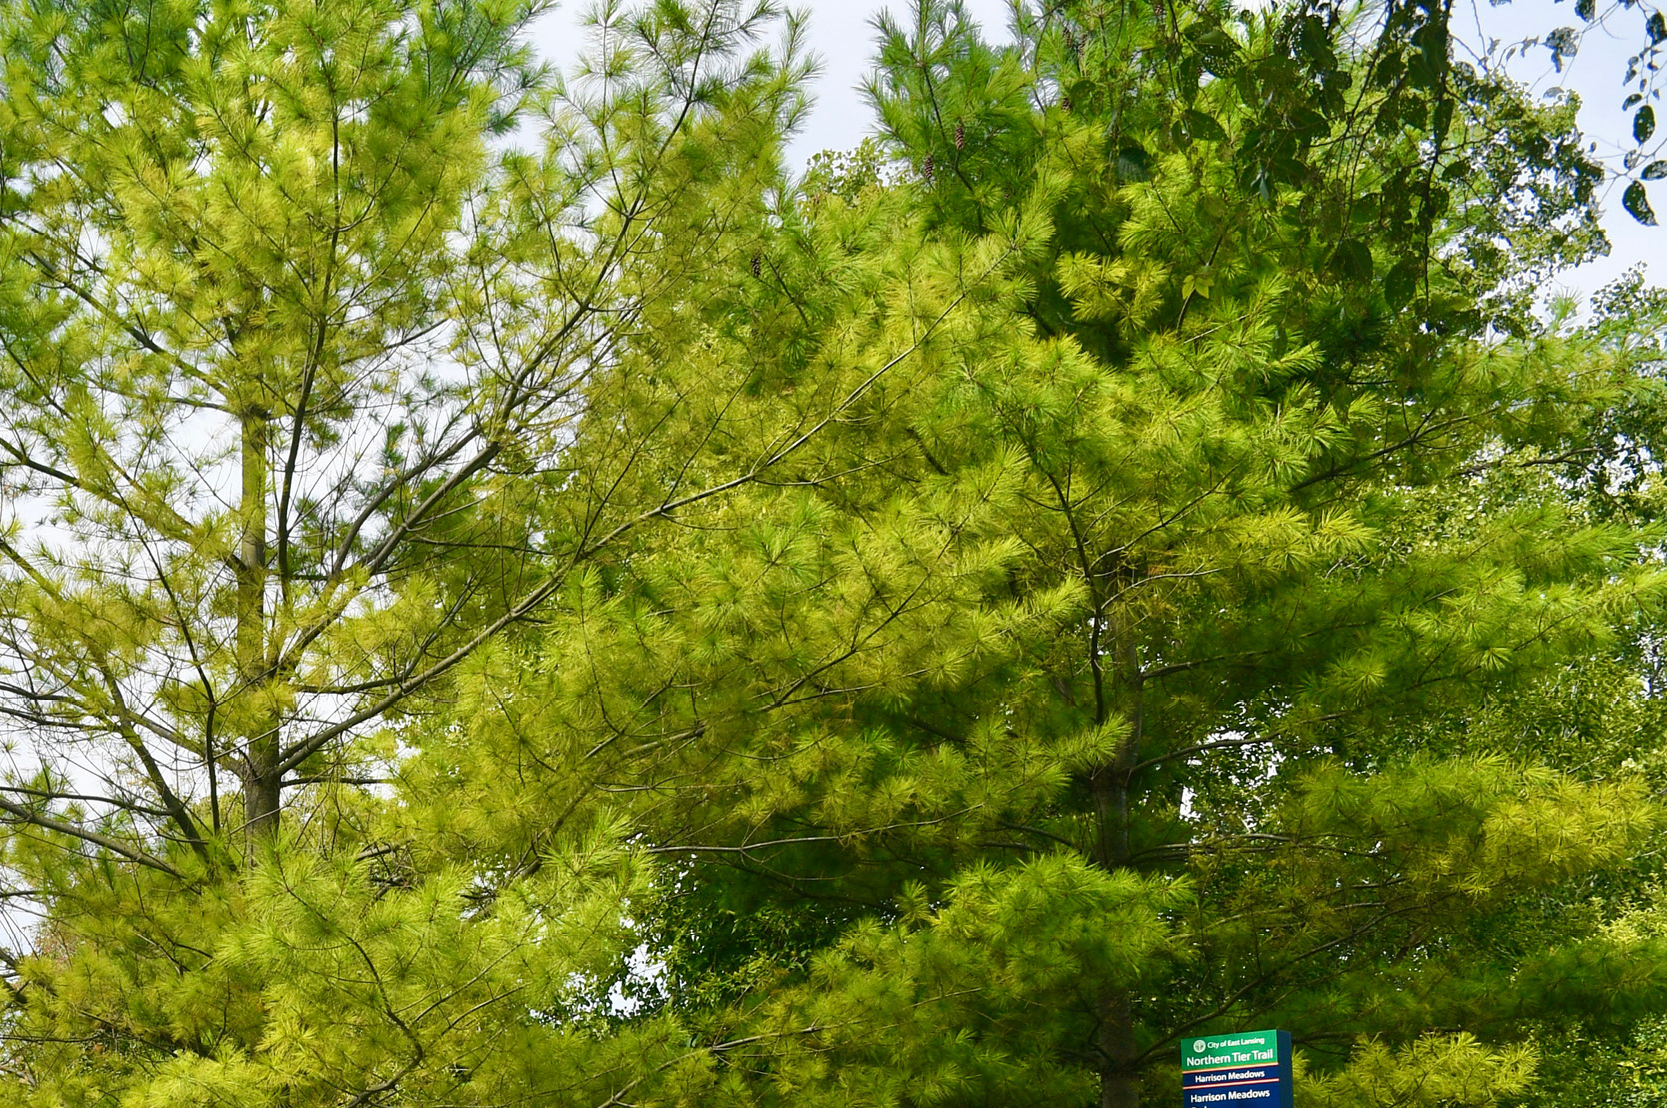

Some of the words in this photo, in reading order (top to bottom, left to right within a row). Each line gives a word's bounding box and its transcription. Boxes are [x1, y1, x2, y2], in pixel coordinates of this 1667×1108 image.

[1241, 1037, 1265, 1045] Lansing
[1187, 1055, 1230, 1066] Northern
[1232, 1052, 1250, 1062] Tier
[1252, 1049, 1273, 1059] Trail
[1195, 1074, 1226, 1083] Harrison
[1228, 1071, 1265, 1080] Meadows
[1191, 1093, 1226, 1103] Harrison
[1228, 1090, 1270, 1099] Meadows
